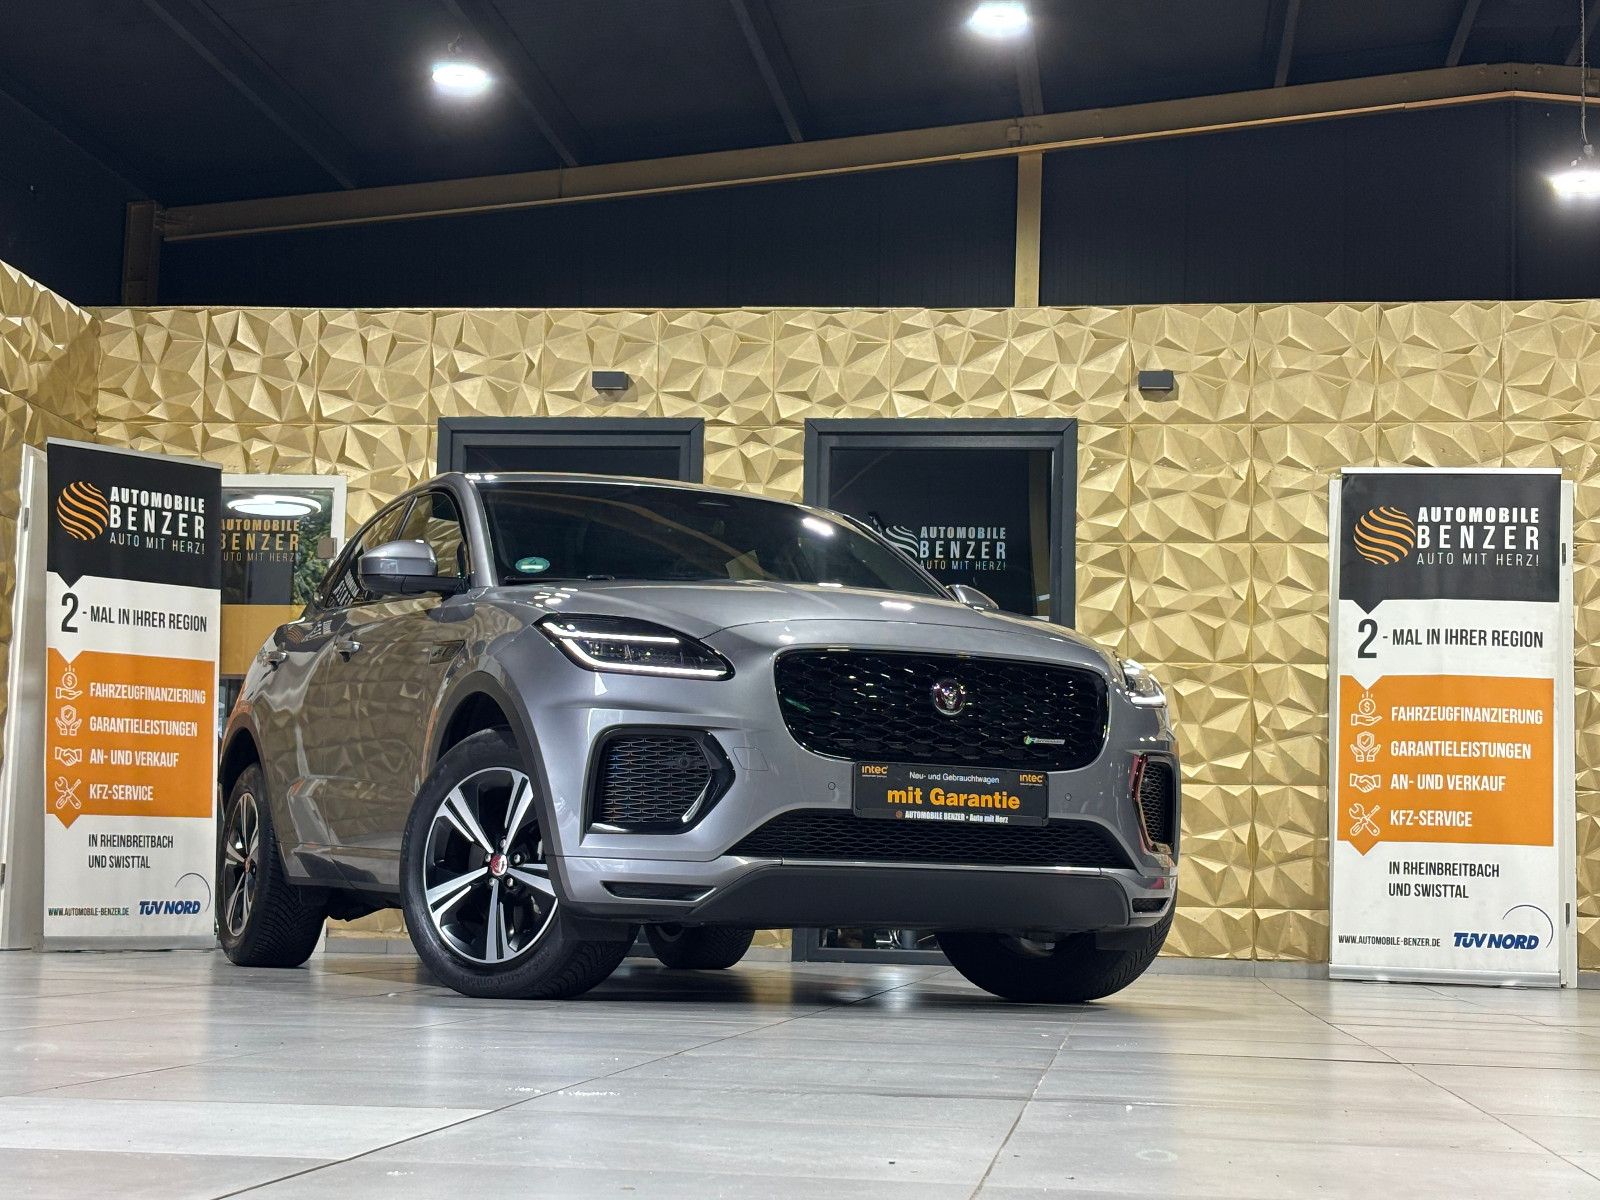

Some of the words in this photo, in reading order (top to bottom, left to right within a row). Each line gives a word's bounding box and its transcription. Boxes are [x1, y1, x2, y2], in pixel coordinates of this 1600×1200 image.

[110, 486, 205, 514] AUTOMOBILE
[109, 504, 205, 540] BENZER
[1417, 506, 1540, 524] AUTOMOBILE
[920, 526, 1006, 539] AUTOMOBILE
[1417, 525, 1540, 550] BENZER
[109, 532, 140, 547] AUTO
[146, 536, 166, 550] MIT
[172, 540, 205, 555] HERZ!
[919, 541, 1006, 560] BENZER
[222, 552, 242, 561] UTO
[247, 552, 263, 561] MIT
[919, 560, 946, 570] AUTO
[951, 560, 969, 570] MIT
[975, 560, 1006, 571] HERZ!
[1417, 552, 1454, 565] AUTO
[1462, 552, 1488, 566] MIT
[1496, 553, 1540, 567] HERZ!
[61, 593, 79, 633] 2
[90, 605, 116, 625] MAL
[118, 608, 131, 626] IN
[133, 609, 167, 629] IHRER
[168, 612, 207, 632] REGION
[1357, 618, 1378, 659] 2
[1392, 628, 1423, 645] MAL
[1426, 629, 1441, 646] IN
[1445, 629, 1487, 647] IHRER
[1491, 630, 1544, 648] REGION
[90, 682, 206, 704] FAHRZEUGFINANZIERUNG
[1391, 706, 1543, 725] FAHRZEUGFINANZIERUNG
[89, 716, 198, 737] GARANTIELEISTUNGEN
[89, 748, 108, 765] AN-
[111, 750, 132, 766] UND
[135, 751, 179, 768] VERKAUF
[1390, 740, 1532, 760] GARANTIELEISTUNGEN
[909, 771, 926, 779] Neu-
[942, 773, 1000, 785] Gebrauchtwagen
[1390, 774, 1414, 790] AN-
[1417, 774, 1443, 790] UND
[1447, 775, 1506, 792] VERKAUF
[89, 784, 154, 801] KFZ-SERVICE
[887, 786, 923, 804] mit
[929, 787, 1021, 810] Garantie
[905, 811, 943, 820] AUTOMOBILE
[944, 812, 966, 821] BENZER
[1390, 809, 1472, 827] KFZ-SERVICE
[88, 834, 98, 848] IN
[100, 834, 174, 849] RHEINBREITBACH
[88, 855, 107, 868] UND
[108, 855, 151, 869] SWISTTAL
[1389, 861, 1400, 875] IN
[1403, 861, 1500, 878] RHEINBREITBACH
[1389, 883, 1411, 897] UND
[1414, 883, 1469, 899] SWISTTAL
[48, 907, 130, 916] WWW.AUTOMOBILE-BENZER.DE
[163, 901, 201, 915] NORD
[1338, 934, 1441, 948] WWW.AUTOMOBILE-BENZER.DE
[1487, 933, 1539, 950] NORD
